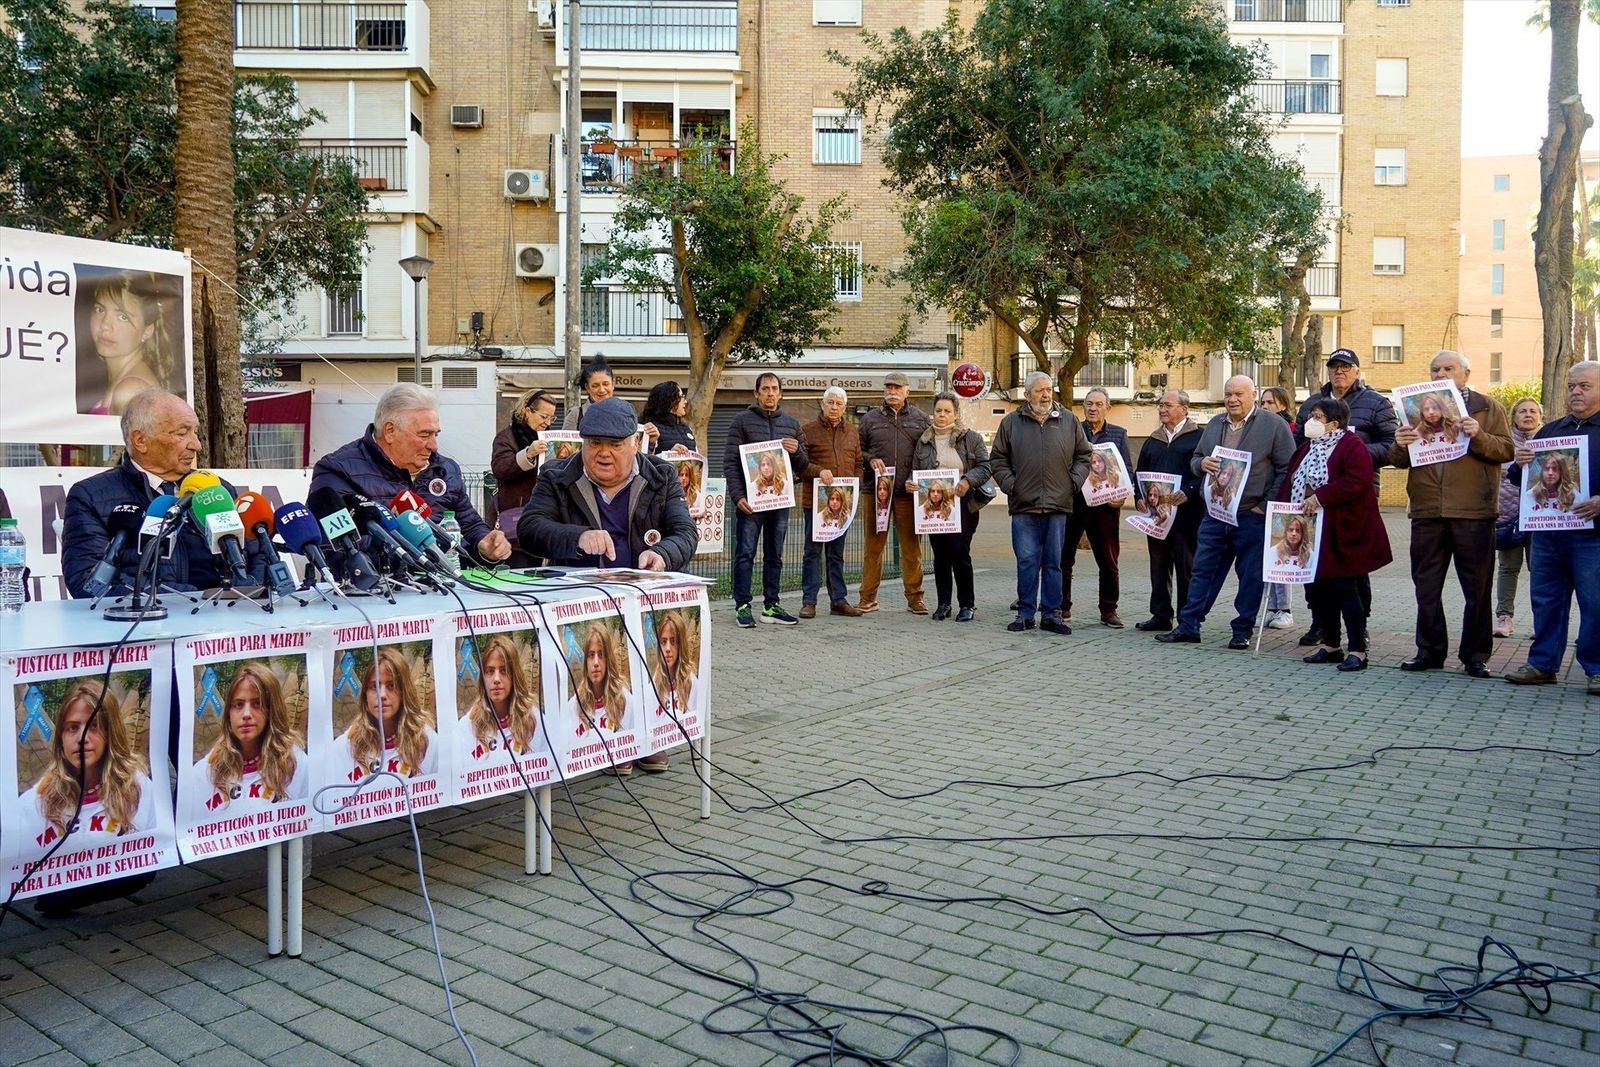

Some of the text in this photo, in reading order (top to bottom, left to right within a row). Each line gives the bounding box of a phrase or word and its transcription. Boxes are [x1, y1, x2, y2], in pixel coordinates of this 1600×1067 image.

[0, 257, 70, 297] ida
[0, 321, 69, 363] UÉ?
[241, 367, 283, 377] ssos
[615, 376, 643, 386] Roke
[780, 377, 872, 388] Comidas Caseras
[400, 490, 418, 511] 7
[490, 611, 510, 626] PARA
[551, 603, 583, 620] “JUSTICIA
[584, 600, 600, 613] PARA
[333, 618, 434, 645] “JUSTICIA PARA MARTA”
[186, 631, 312, 660] “JUSTICIA PARA MARTA”
[8, 652, 68, 678] “JUSTICIA
[72, 650, 104, 668] PARA
[467, 763, 510, 783] REPETICIÓN
[525, 757, 548, 771] JUICIO
[567, 761, 583, 773] PARA
[584, 759, 592, 769] LA
[342, 779, 437, 808] RPETICIÓN DE JUICIO
[461, 769, 554, 799] PARA LA NIÑA DE EVILLA”
[197, 804, 306, 838] REPETICIÓN DEL JUICIO
[334, 811, 358, 825] PARA
[361, 808, 371, 820] LA
[373, 803, 393, 816] NIÑA
[395, 800, 406, 813] DE
[97, 844, 118, 859] DEL
[120, 836, 155, 855] JUICIO
[191, 817, 313, 856] PARA LA NIÑA DE SEVILLA”
[10, 850, 164, 894] PARA LA NIÑA DE SEVILLA”
